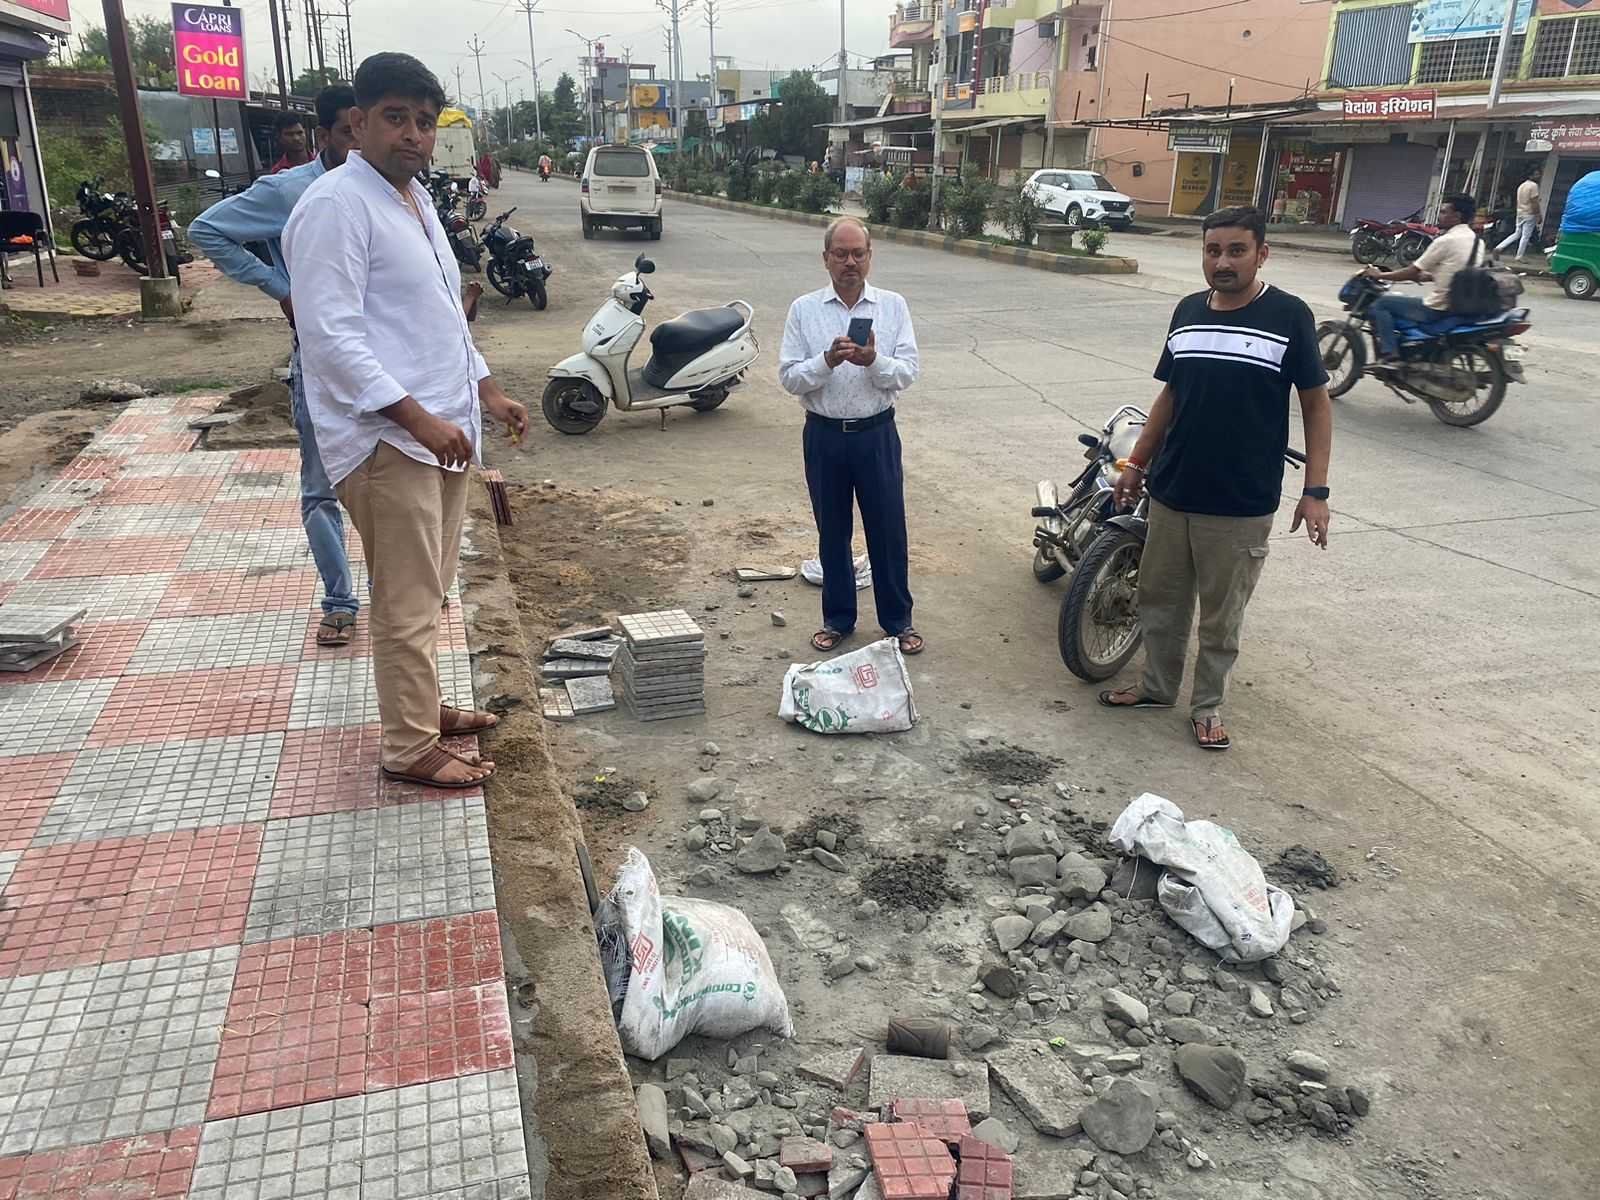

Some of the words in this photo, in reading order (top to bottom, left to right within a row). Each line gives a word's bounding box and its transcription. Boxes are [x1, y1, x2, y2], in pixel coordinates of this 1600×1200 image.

[184, 8, 232, 26] CAPRI
[201, 22, 232, 33] LOANS
[183, 44, 240, 67] Gold
[184, 68, 240, 91] Loan
[1344, 98, 1377, 114] वेदांश
[1380, 97, 1433, 115] इरिगेशन
[1551, 124, 1567, 141] कृषि
[1568, 125, 1584, 137] सेवा
